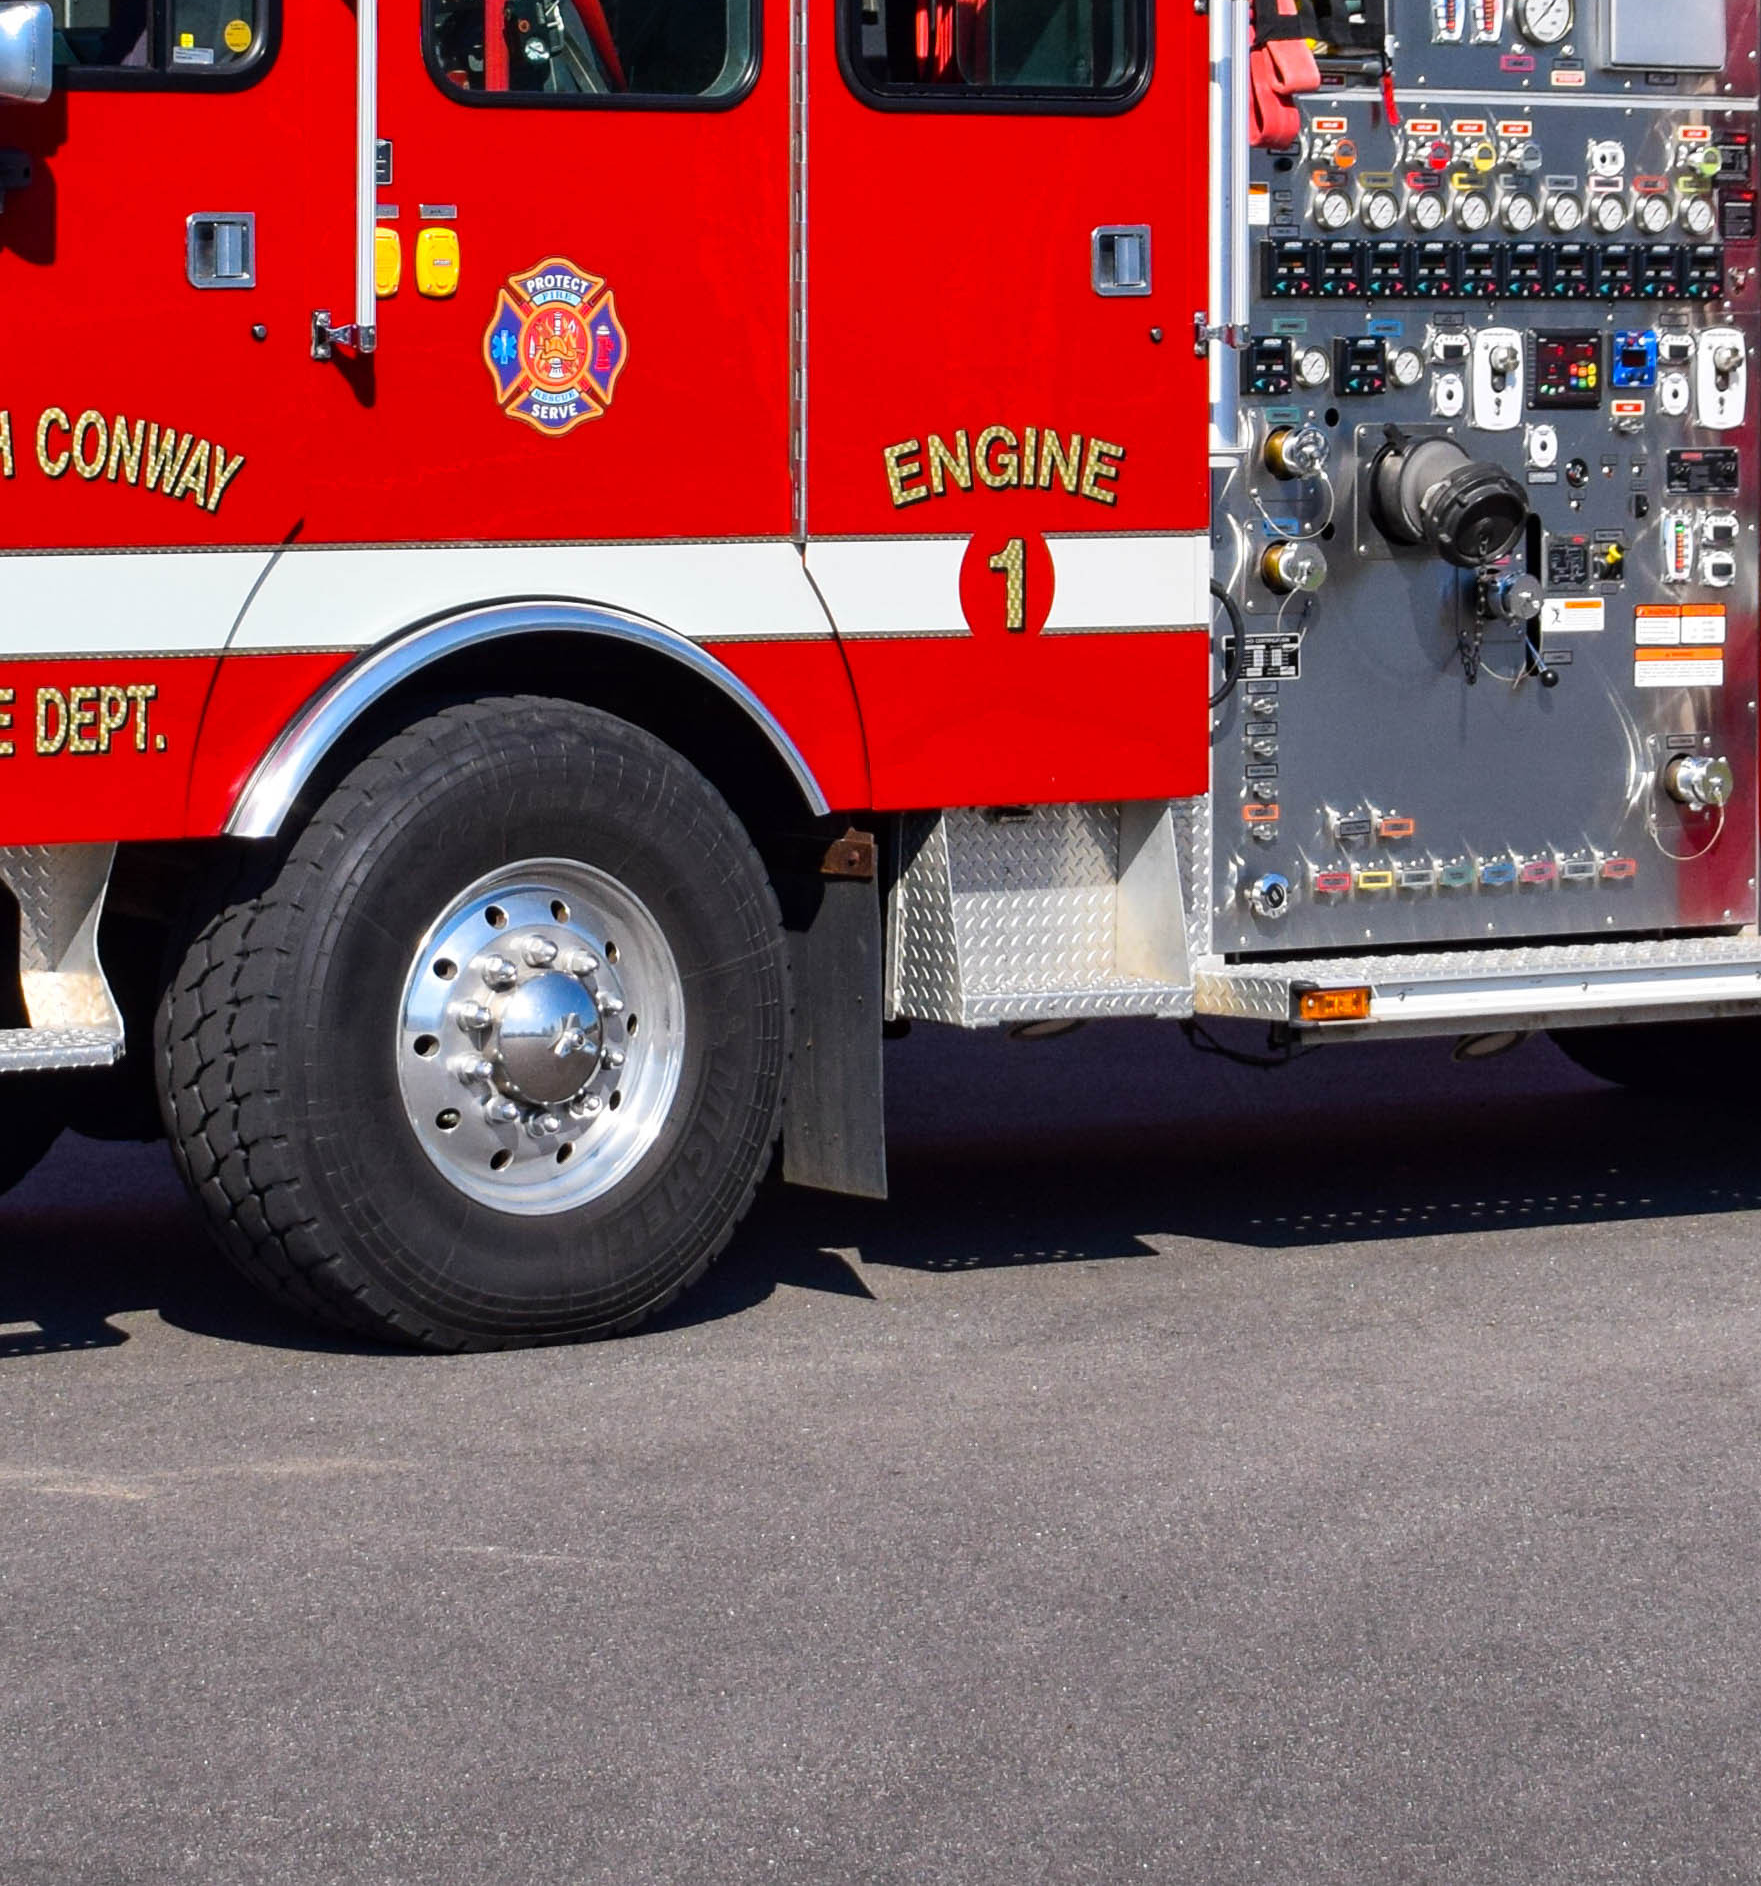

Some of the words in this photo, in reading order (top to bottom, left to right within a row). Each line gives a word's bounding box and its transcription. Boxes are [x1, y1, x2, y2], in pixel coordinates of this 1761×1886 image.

[526, 274, 589, 294] PROTECT
[542, 289, 573, 302] FIRE
[530, 403, 579, 420] SERVE
[533, 388, 577, 403] RESCUE
[35, 406, 245, 512] CONWAY
[883, 424, 1125, 507] ENGINE
[988, 537, 1026, 631] 1
[35, 683, 167, 755] DEPT.
